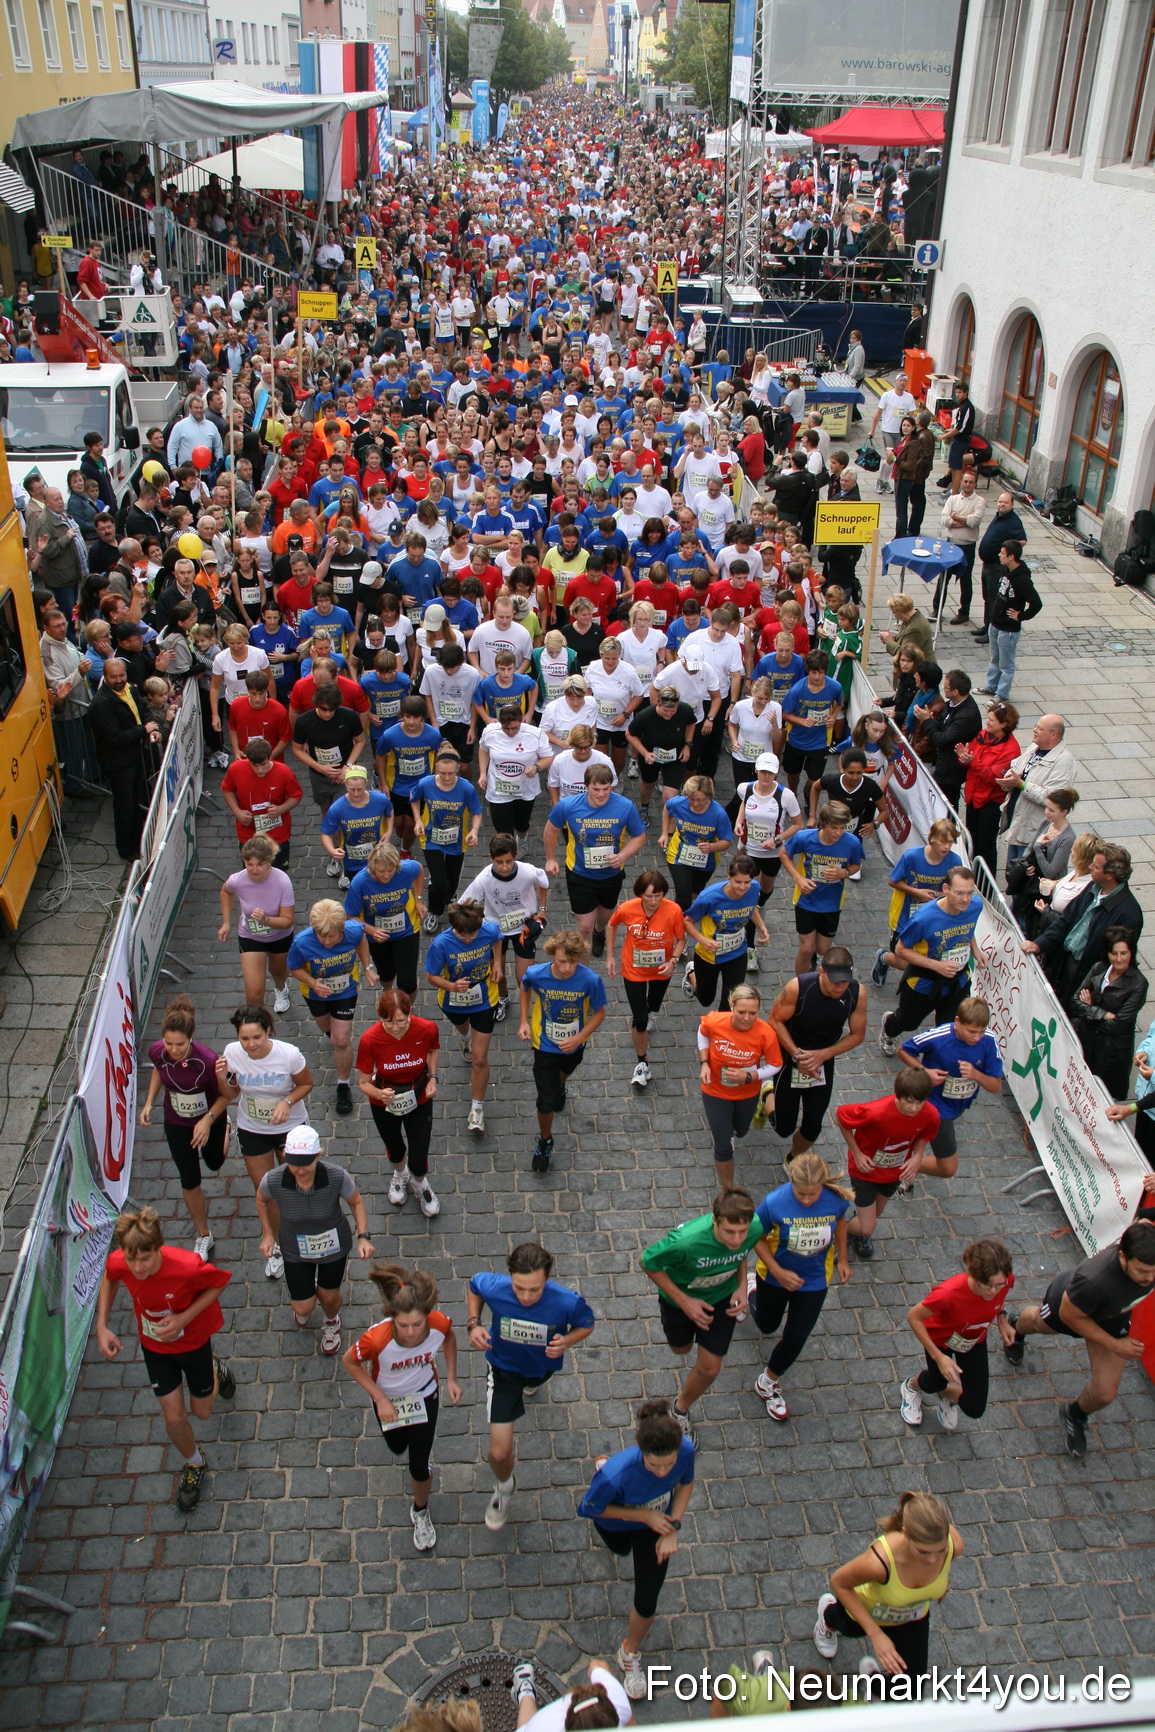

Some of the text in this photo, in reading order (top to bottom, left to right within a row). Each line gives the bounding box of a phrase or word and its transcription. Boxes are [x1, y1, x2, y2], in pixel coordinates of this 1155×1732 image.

[841, 57, 951, 76] www.barowski-ag
[360, 246, 371, 261] A
[662, 270, 673, 286] A
[819, 514, 875, 524] Schnupper-
[837, 526, 856, 534] lauf
[439, 833, 457, 841] 5110
[354, 848, 372, 856] 5109
[688, 852, 706, 862] 5232
[370, 888, 406, 900] NEUMARKTER
[383, 919, 403, 928] 5116
[725, 936, 743, 948] 5143
[322, 957, 352, 968] STADTLAUF
[457, 952, 486, 963] STADTLAUF
[459, 993, 480, 1001] 5128
[545, 994, 577, 1002] STADTLAUF
[546, 989, 585, 998] NEUMARKTER
[555, 1029, 577, 1038] 5019
[719, 1044, 755, 1057] Fischer
[395, 1053, 411, 1062] DAV
[383, 1057, 424, 1070] Röthenbach
[954, 1082, 976, 1092] 5173
[1069, 1056, 1098, 1109] Service-Line:
[180, 1101, 204, 1110] 5236
[391, 1098, 414, 1110] 5023
[292, 1142, 308, 1150] LEX
[1061, 1081, 1128, 1212] www.jura-gebaeudeservice.de
[1054, 1106, 1101, 1207] Gebäudereinigung
[1051, 1122, 1094, 1226] Hausmeisterdienst
[1046, 1140, 1099, 1256] Arbeitsbühnenverleih
[794, 1215, 836, 1223] NEUMARKTER
[308, 1233, 331, 1242] Roswitha
[801, 1229, 819, 1237] Sophia
[310, 1239, 335, 1251] 2772
[800, 1238, 826, 1247] 5191
[696, 1250, 750, 1269] Sinupret
[512, 1321, 539, 1330] Benedikt
[514, 1329, 543, 1340] 5016
[392, 1352, 432, 1368] MERZ
[395, 1402, 421, 1414] 5126
